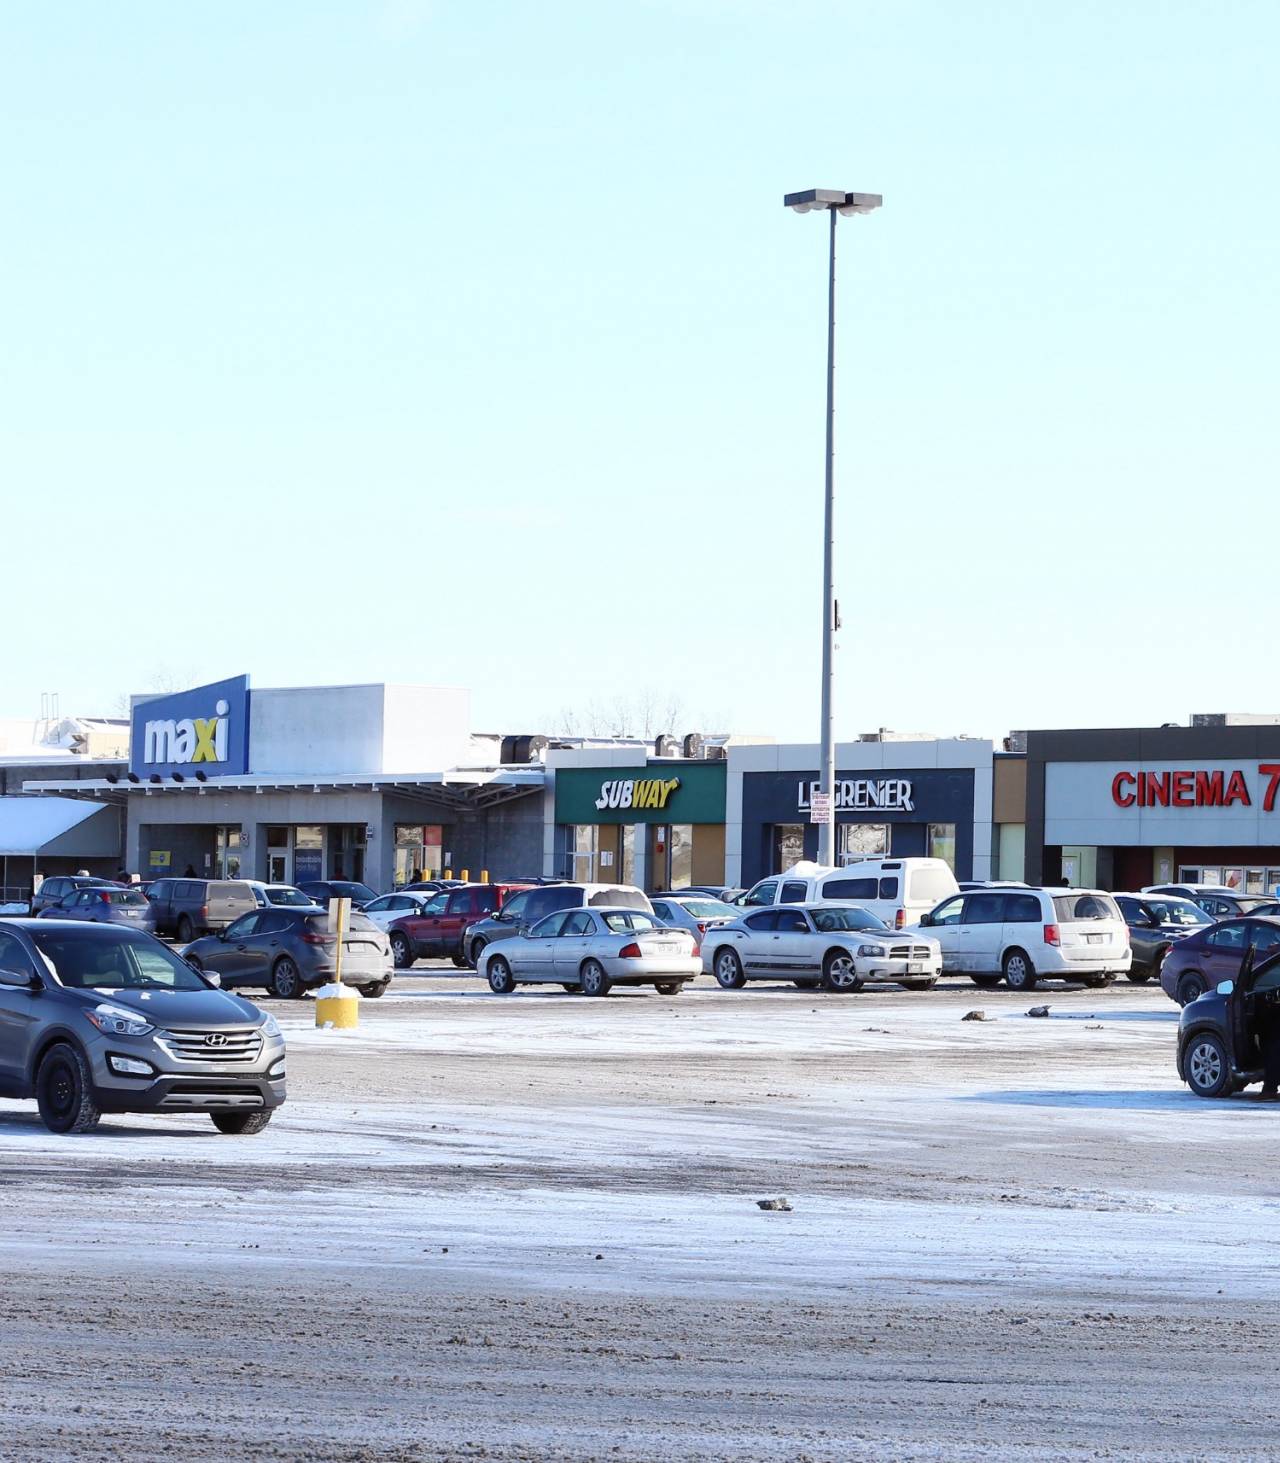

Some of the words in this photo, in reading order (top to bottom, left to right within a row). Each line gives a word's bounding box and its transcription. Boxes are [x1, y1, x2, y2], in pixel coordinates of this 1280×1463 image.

[143, 699, 229, 764] maxi
[595, 777, 680, 810] SUBWAY
[1112, 770, 1252, 807] CINEMA
